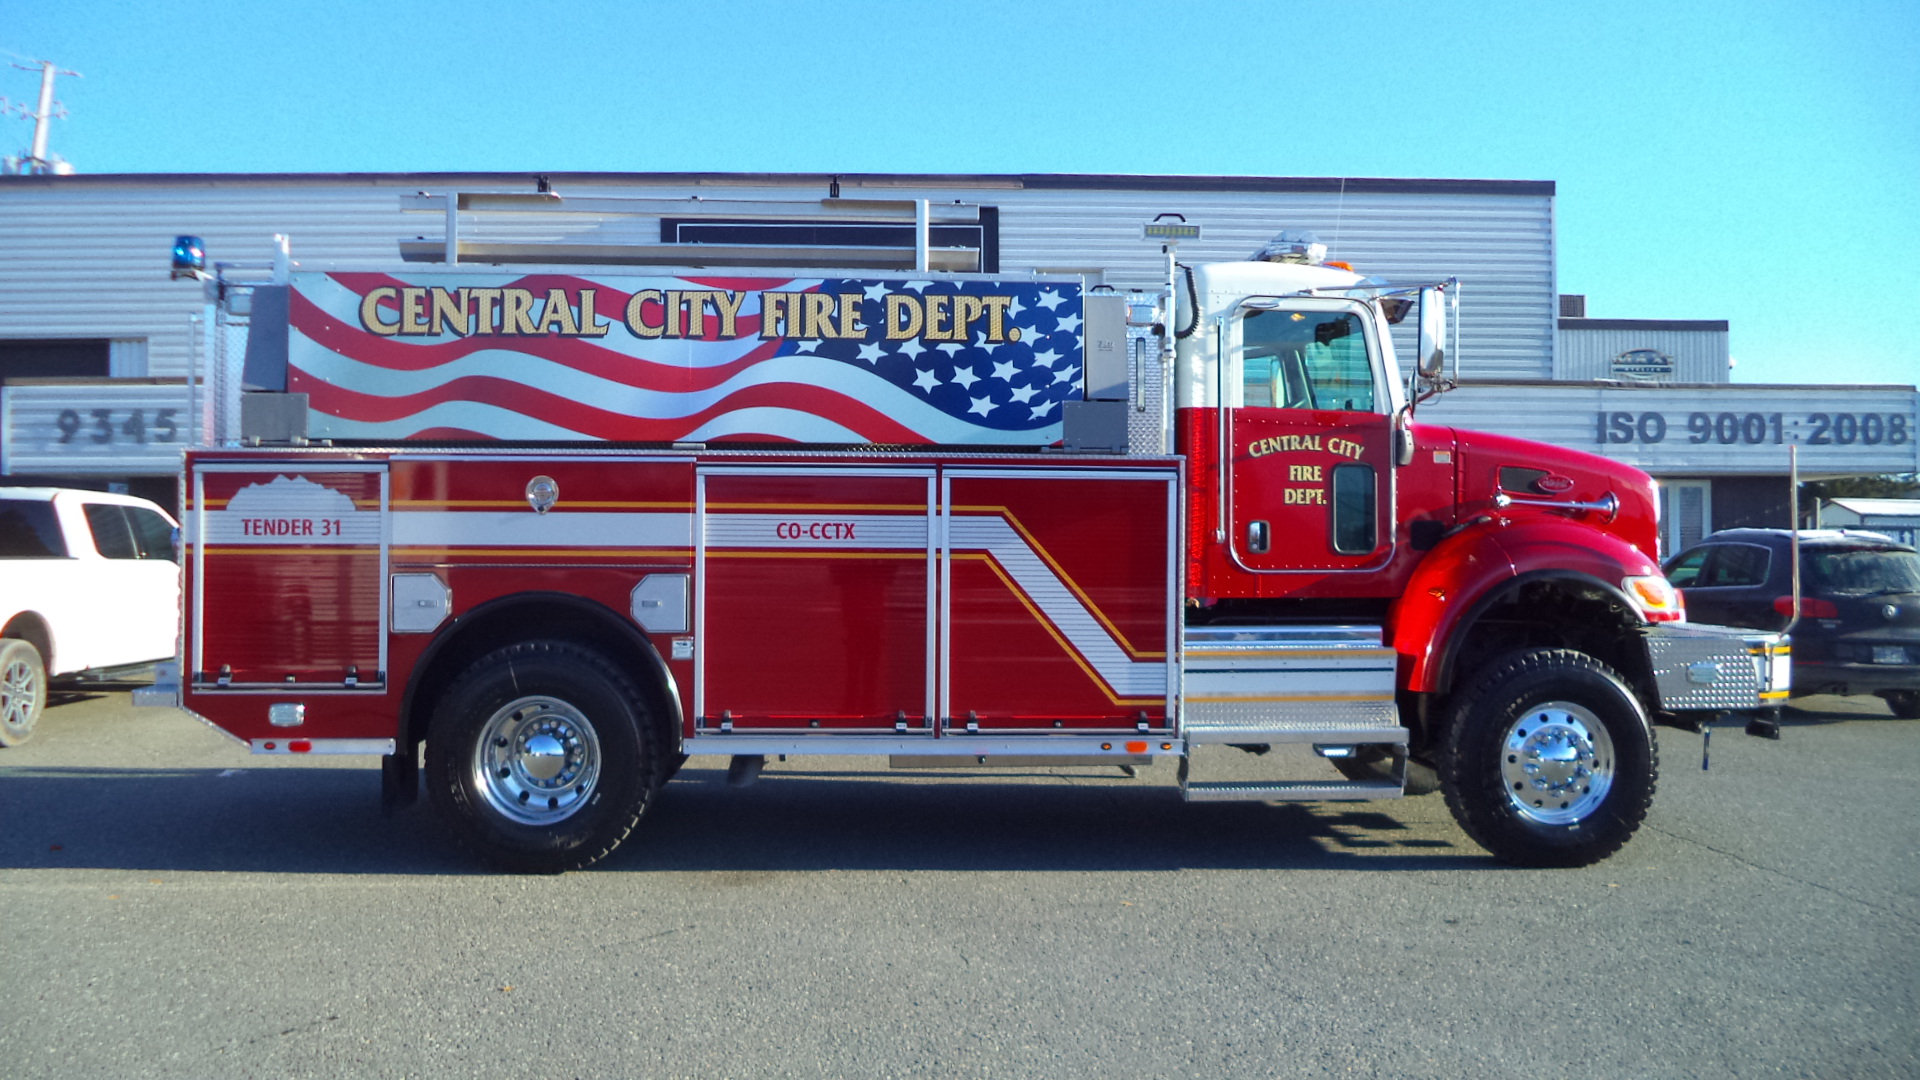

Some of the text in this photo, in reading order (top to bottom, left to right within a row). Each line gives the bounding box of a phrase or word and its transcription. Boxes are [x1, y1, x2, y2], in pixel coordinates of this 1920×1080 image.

[359, 286, 1023, 343] CENTRAL CITY FIRE DEPT.
[56, 407, 178, 444] 9345
[1596, 411, 1909, 446] ISO 9001:2008
[1248, 434, 1366, 461] CENTRAL CITY
[1288, 464, 1324, 482] FIRE
[1283, 487, 1328, 506] DEPT.
[241, 518, 342, 537] TENDER 31
[776, 521, 857, 540] CO-CCTX
